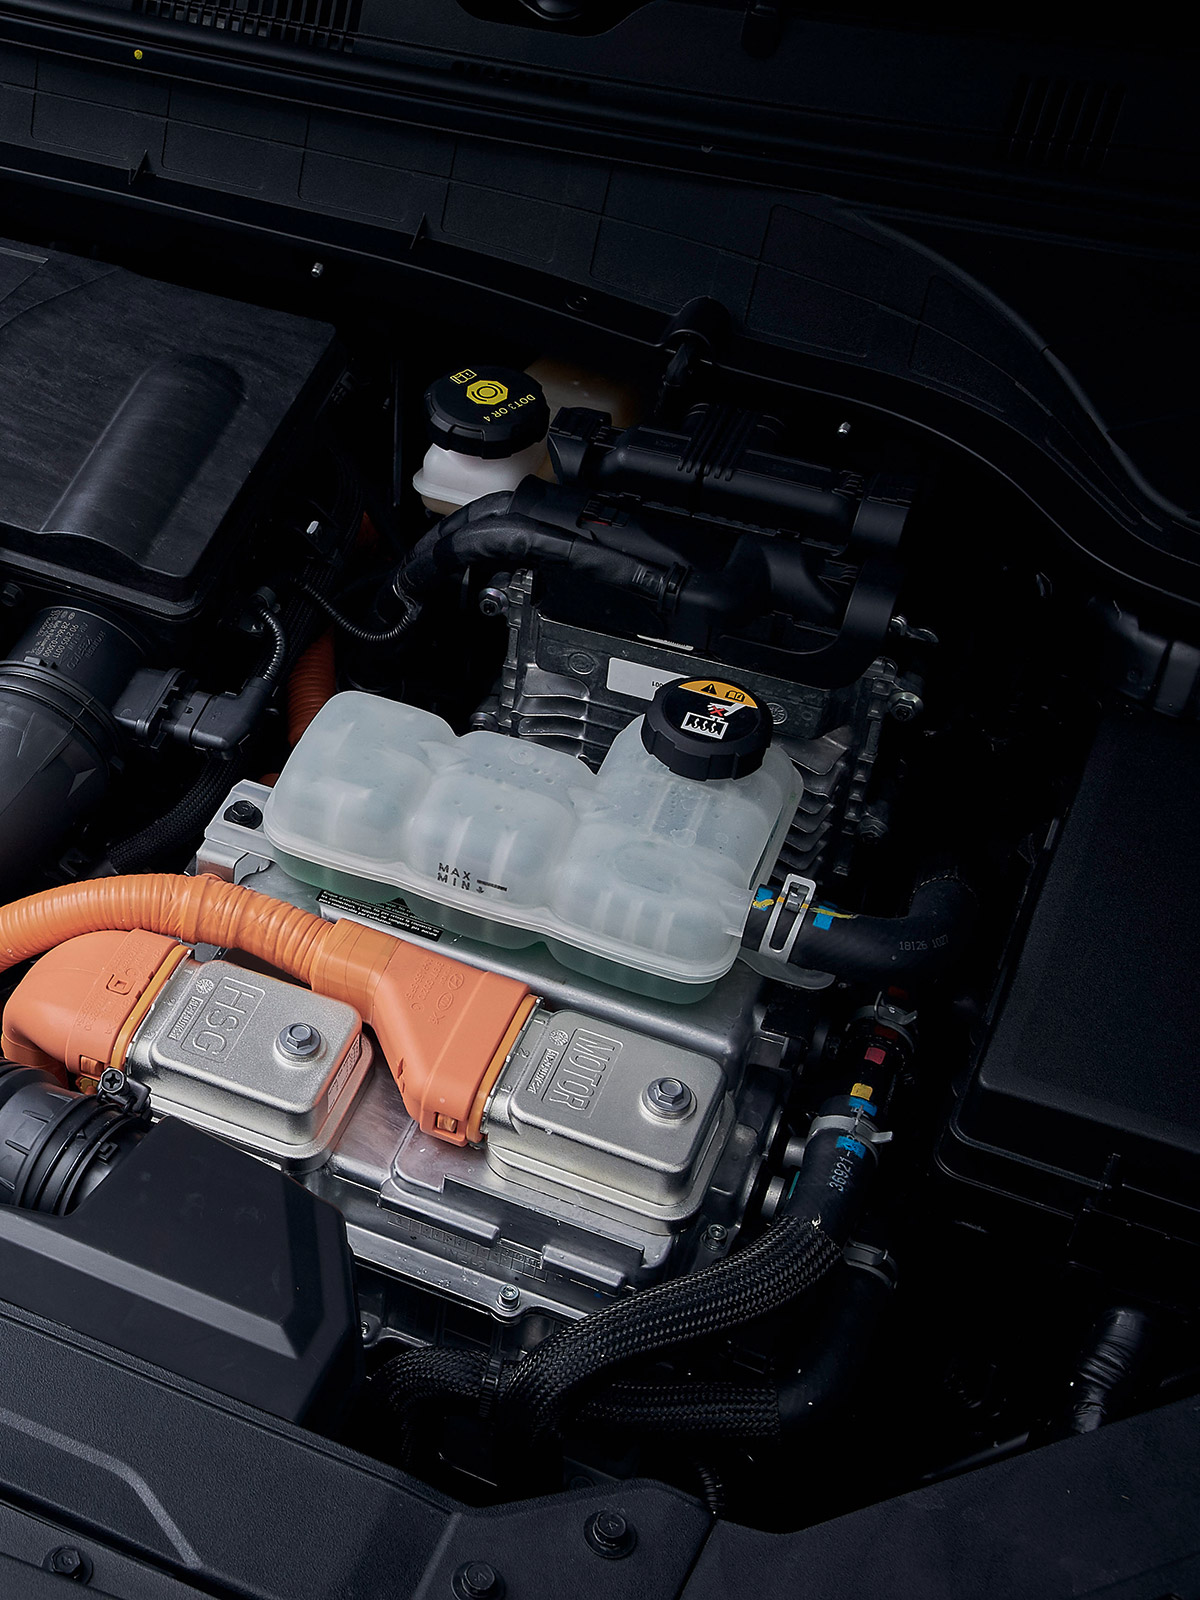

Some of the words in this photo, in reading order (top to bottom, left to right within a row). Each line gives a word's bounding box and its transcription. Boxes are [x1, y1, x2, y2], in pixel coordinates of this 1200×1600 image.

[507, 393, 536, 410] DOT3
[494, 407, 508, 418] OR
[438, 862, 471, 880] MAX
[437, 872, 470, 891] MIN
[192, 983, 256, 1056] HSG
[548, 1035, 615, 1112] MOTOR
